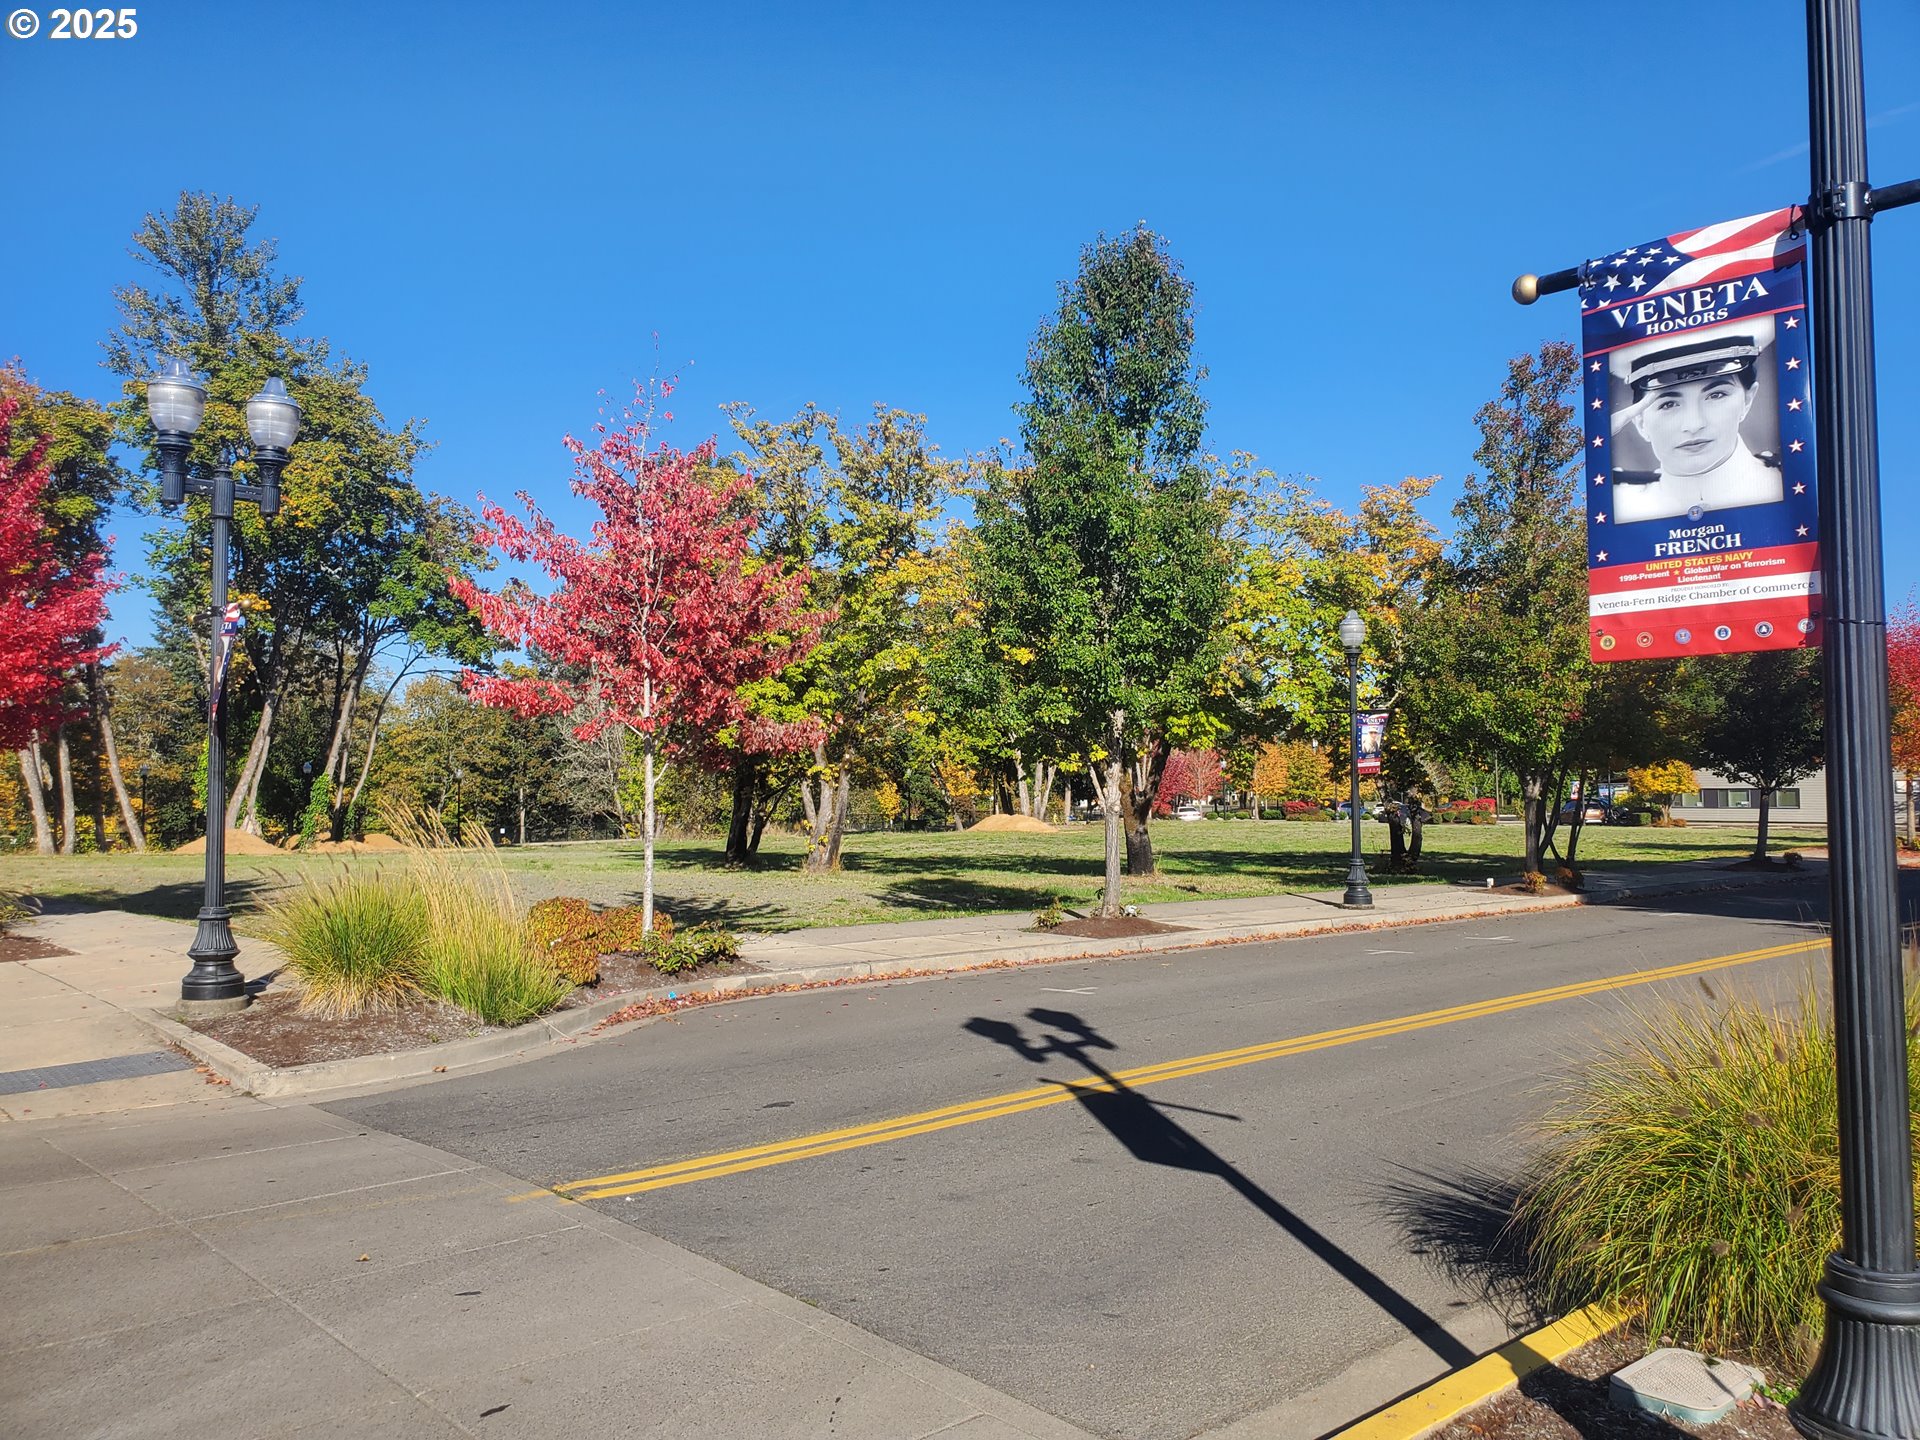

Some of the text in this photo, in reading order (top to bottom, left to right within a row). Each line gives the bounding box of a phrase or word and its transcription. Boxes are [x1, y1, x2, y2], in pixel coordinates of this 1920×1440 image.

[1611, 276, 1769, 328] VENETA
[1646, 307, 1729, 335] HONORS
[1668, 524, 1725, 539] Morgan
[1654, 533, 1742, 557] FRENCH
[1619, 558, 1786, 582] 1998-Present Global War on Terrorism
[1645, 551, 1753, 571] UNITED STATES NAVY
[1677, 572, 1722, 583] Lieutenant
[1597, 581, 1815, 610] Veneta-Fern Ridge Chamber of Commerce
